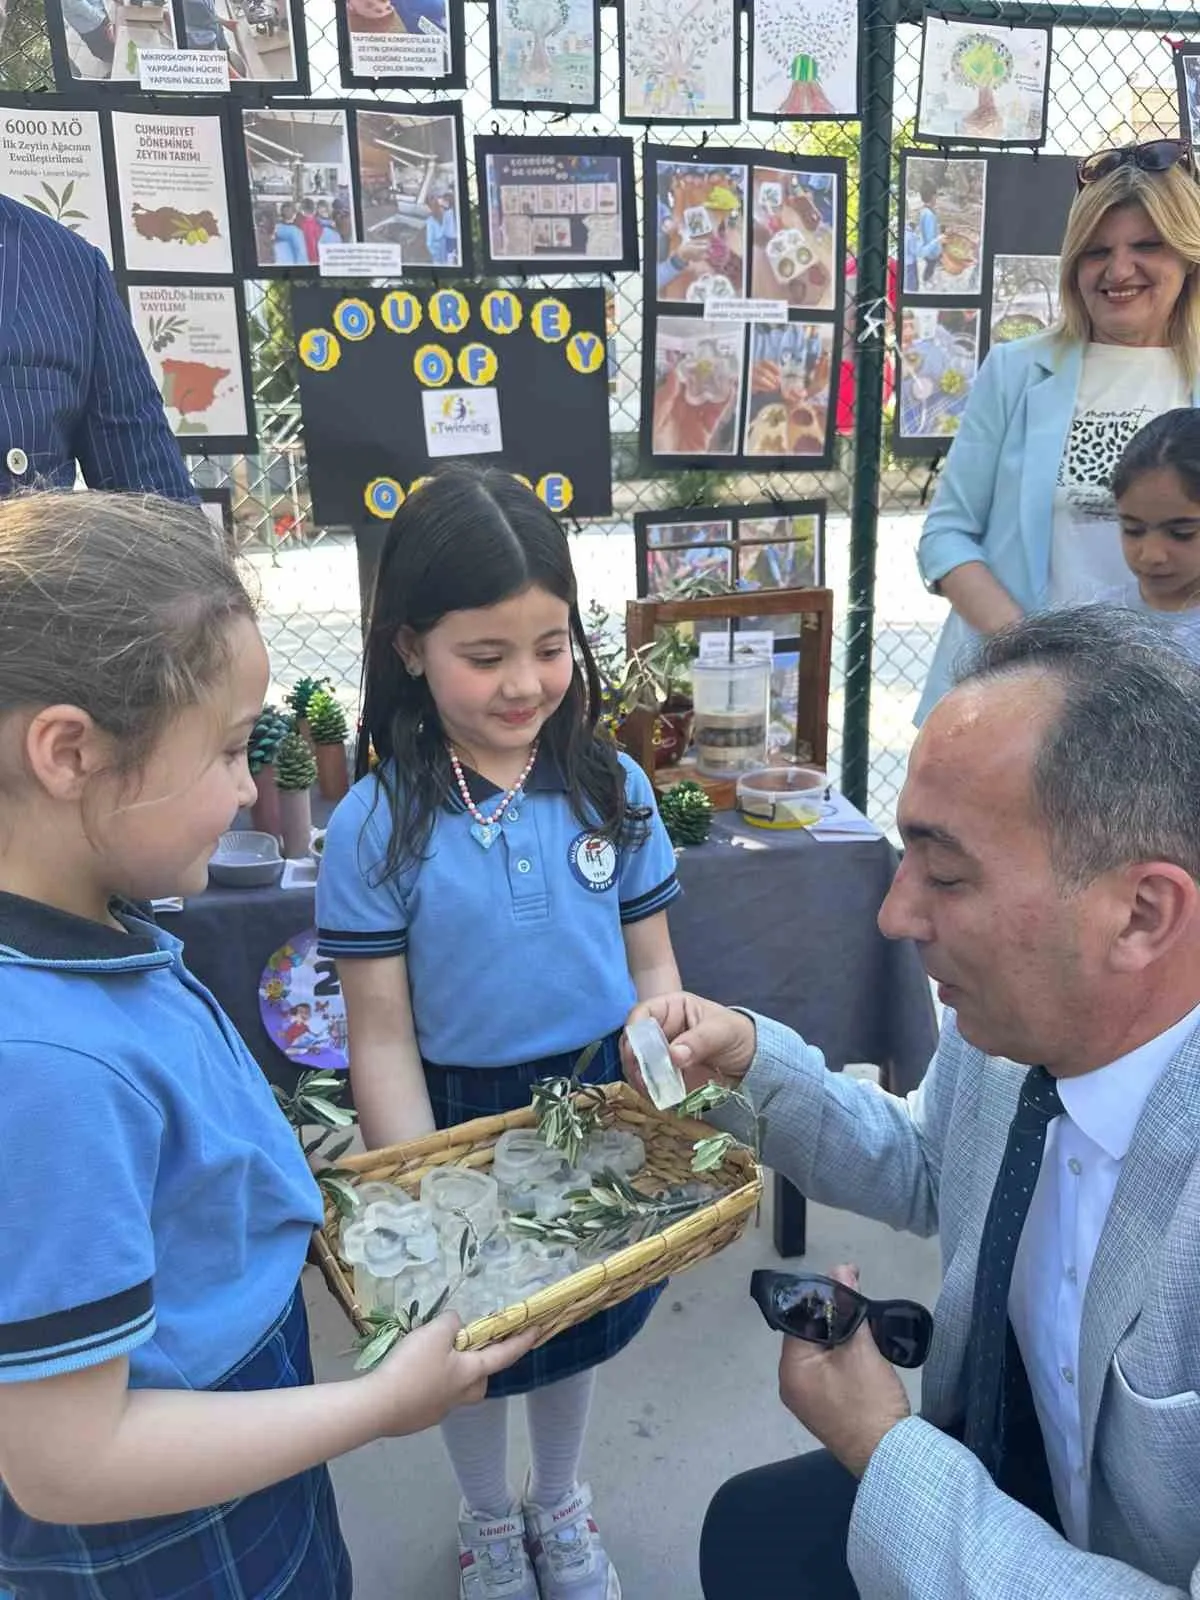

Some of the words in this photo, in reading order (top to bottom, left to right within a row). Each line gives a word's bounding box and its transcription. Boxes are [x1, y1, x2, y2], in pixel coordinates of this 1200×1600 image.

[5, 118, 48, 136] 6000
[51, 117, 82, 136] MÖ
[18, 139, 49, 153] Zeytin
[51, 141, 91, 153] Ağacının
[139, 135, 194, 150] DÖNEMİNDE
[9, 152, 84, 165] Evcilleştirilmesi
[305, 293, 598, 369] JOURNEY
[420, 348, 488, 384] OF
